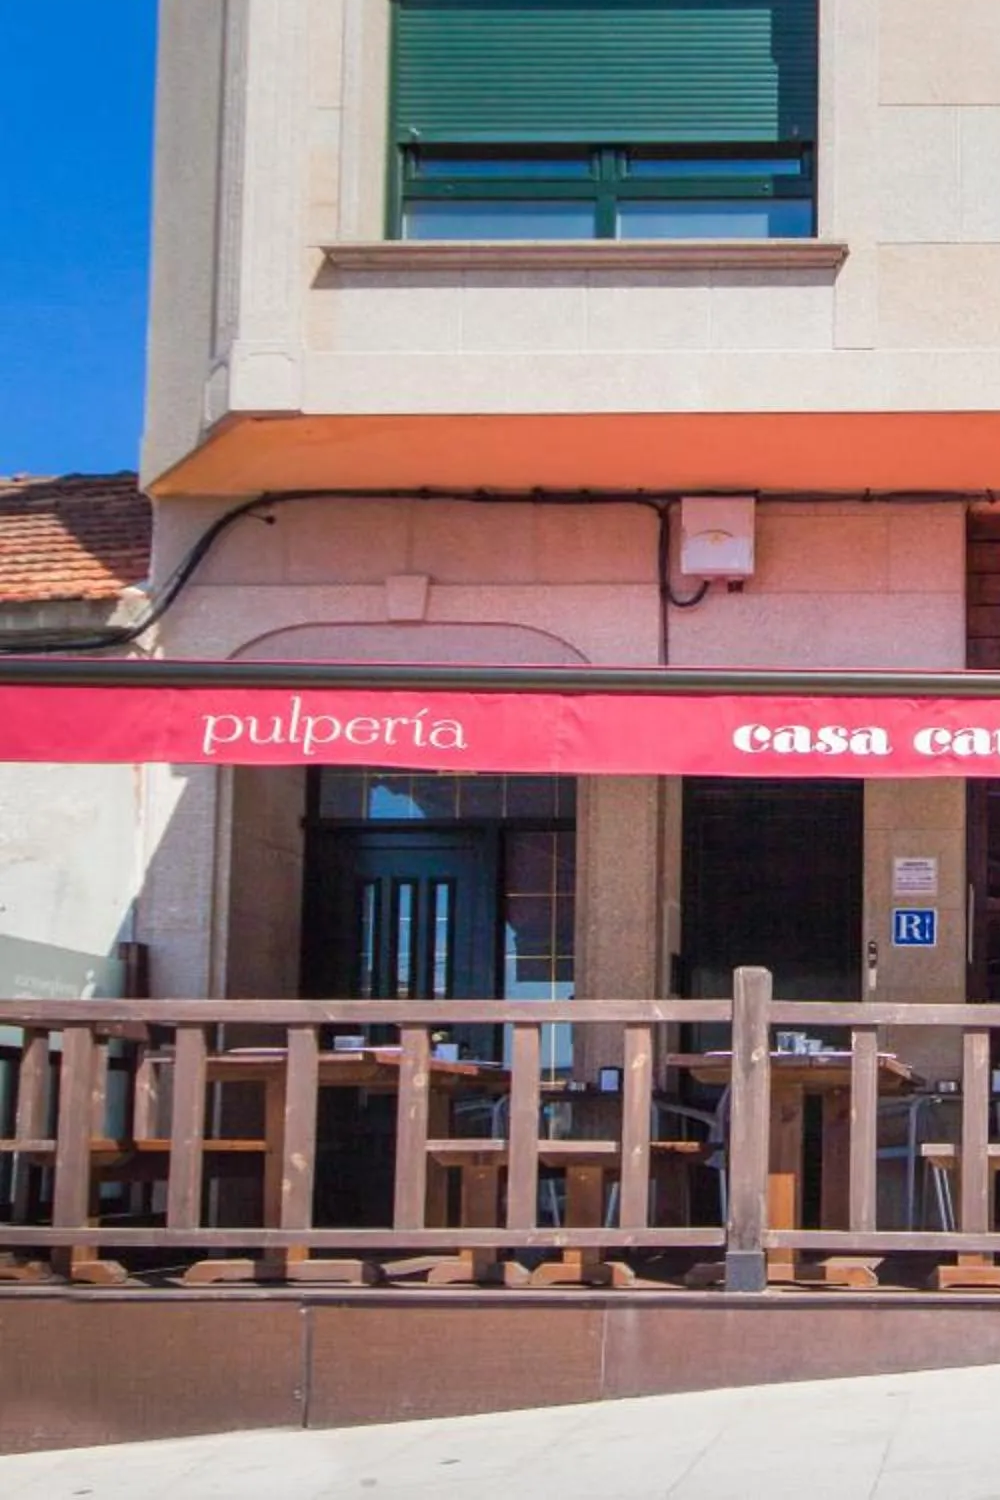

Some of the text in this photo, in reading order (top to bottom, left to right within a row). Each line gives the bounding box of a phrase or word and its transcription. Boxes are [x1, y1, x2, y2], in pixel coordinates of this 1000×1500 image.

[202, 695, 469, 756] pulpería
[732, 723, 894, 756] casa
[896, 912, 924, 941] R
